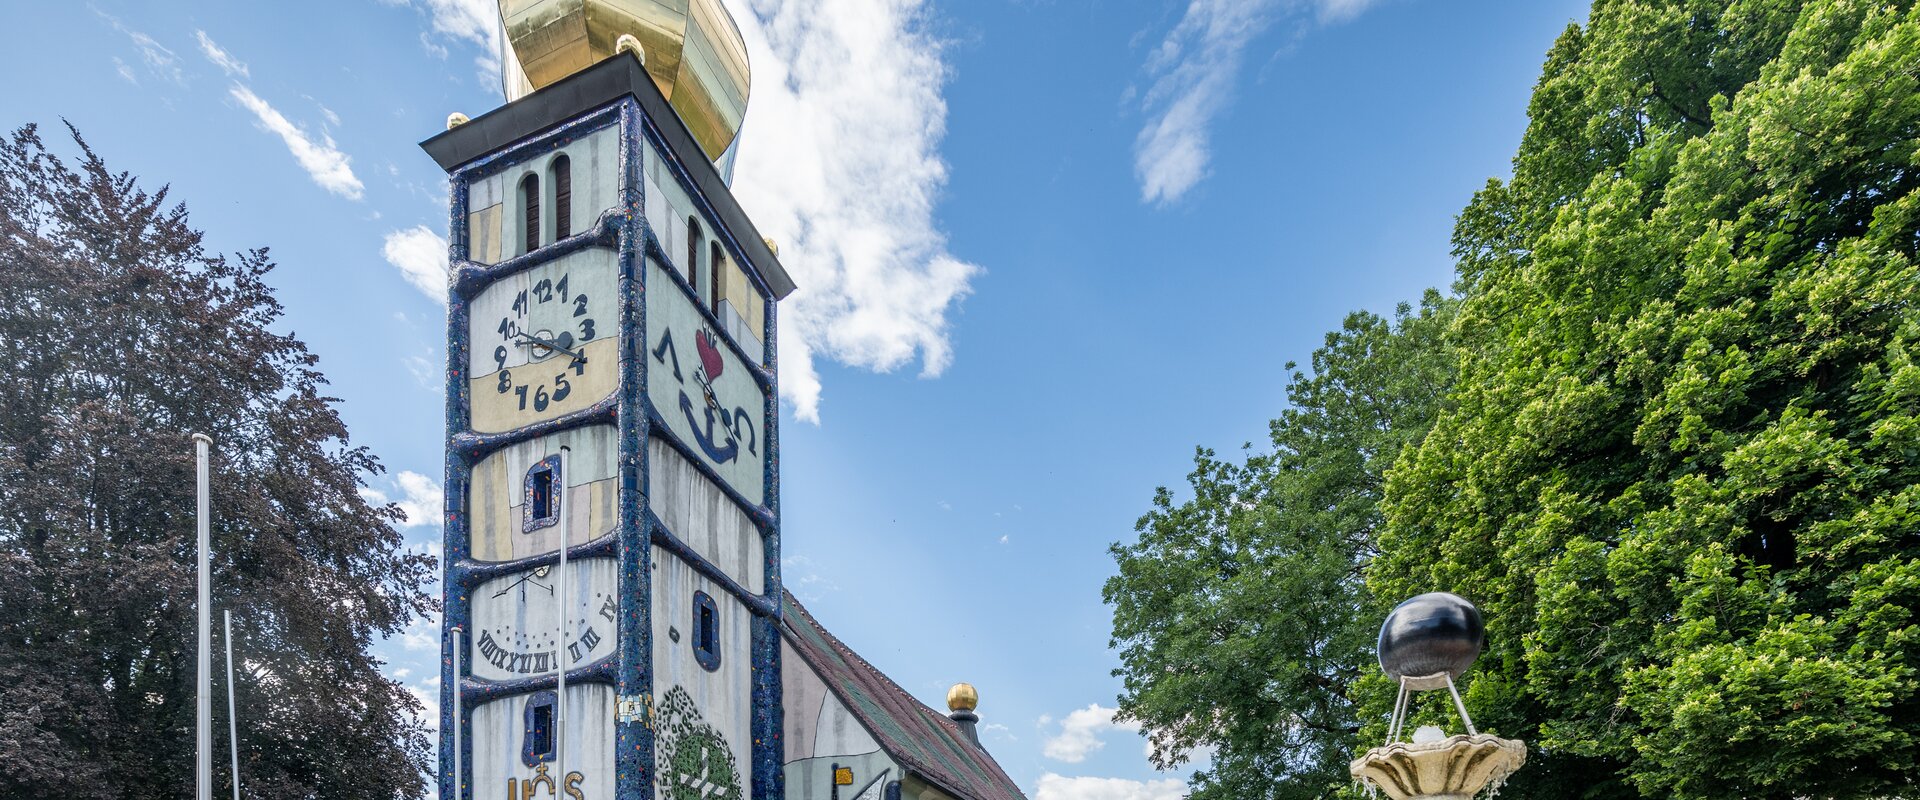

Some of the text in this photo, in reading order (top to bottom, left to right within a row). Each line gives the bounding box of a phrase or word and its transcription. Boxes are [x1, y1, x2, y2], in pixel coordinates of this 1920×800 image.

[532, 279, 553, 304] 12
[555, 273, 568, 304] 1
[512, 289, 528, 319] 11
[573, 294, 588, 317] 2
[497, 317, 515, 341] 10
[578, 319, 595, 341] 3
[494, 345, 507, 371] 9
[568, 348, 588, 376] 4
[497, 370, 512, 394] 8
[552, 373, 571, 402] 5
[515, 385, 528, 411] 7
[534, 385, 549, 412] 6
[568, 641, 582, 663] II
[580, 626, 601, 653] III
